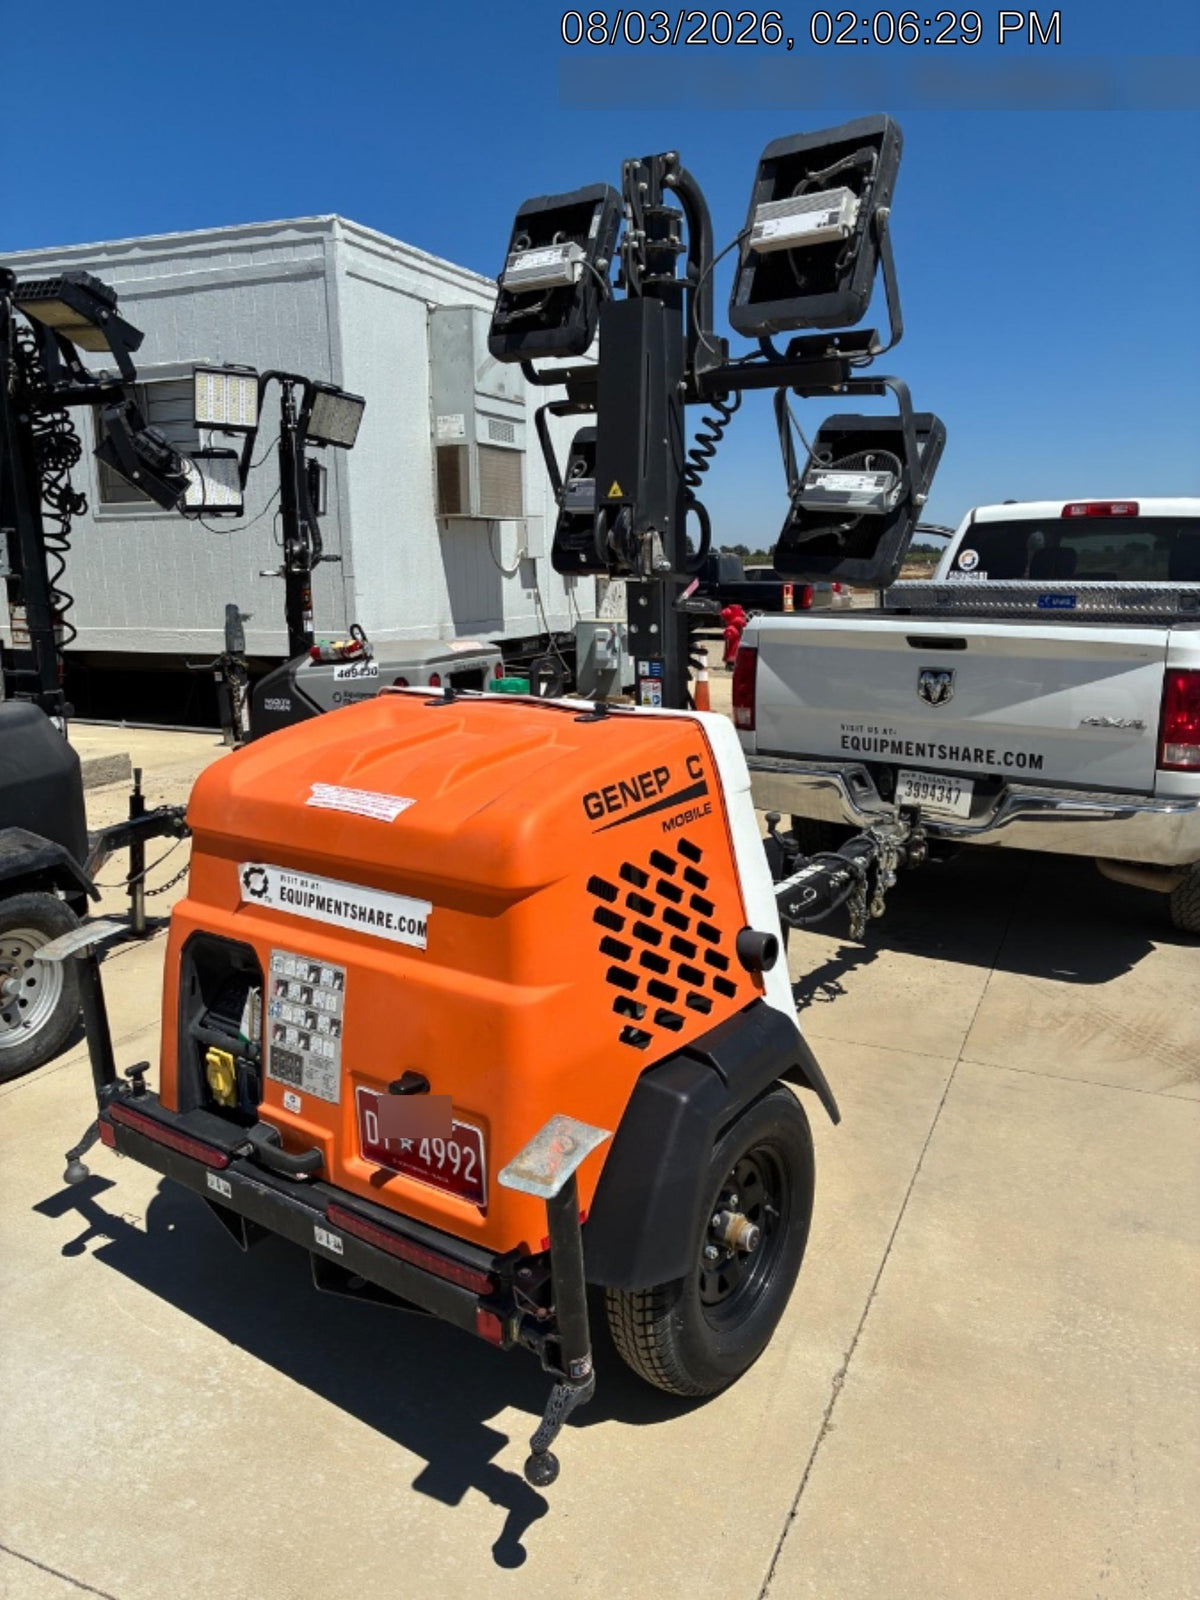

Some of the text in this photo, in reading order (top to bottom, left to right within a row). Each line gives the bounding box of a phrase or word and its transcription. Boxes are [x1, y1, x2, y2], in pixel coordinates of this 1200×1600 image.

[840, 724, 864, 734] VISIT
[867, 726, 879, 735] US
[840, 735, 1044, 770] EQUIPMENTSHARE.COM
[904, 780, 961, 805] 3994347
[661, 802, 712, 833] MOBILE
[280, 874, 298, 886] VISIT
[280, 886, 427, 938] EQUIPMENTSHARE.COM
